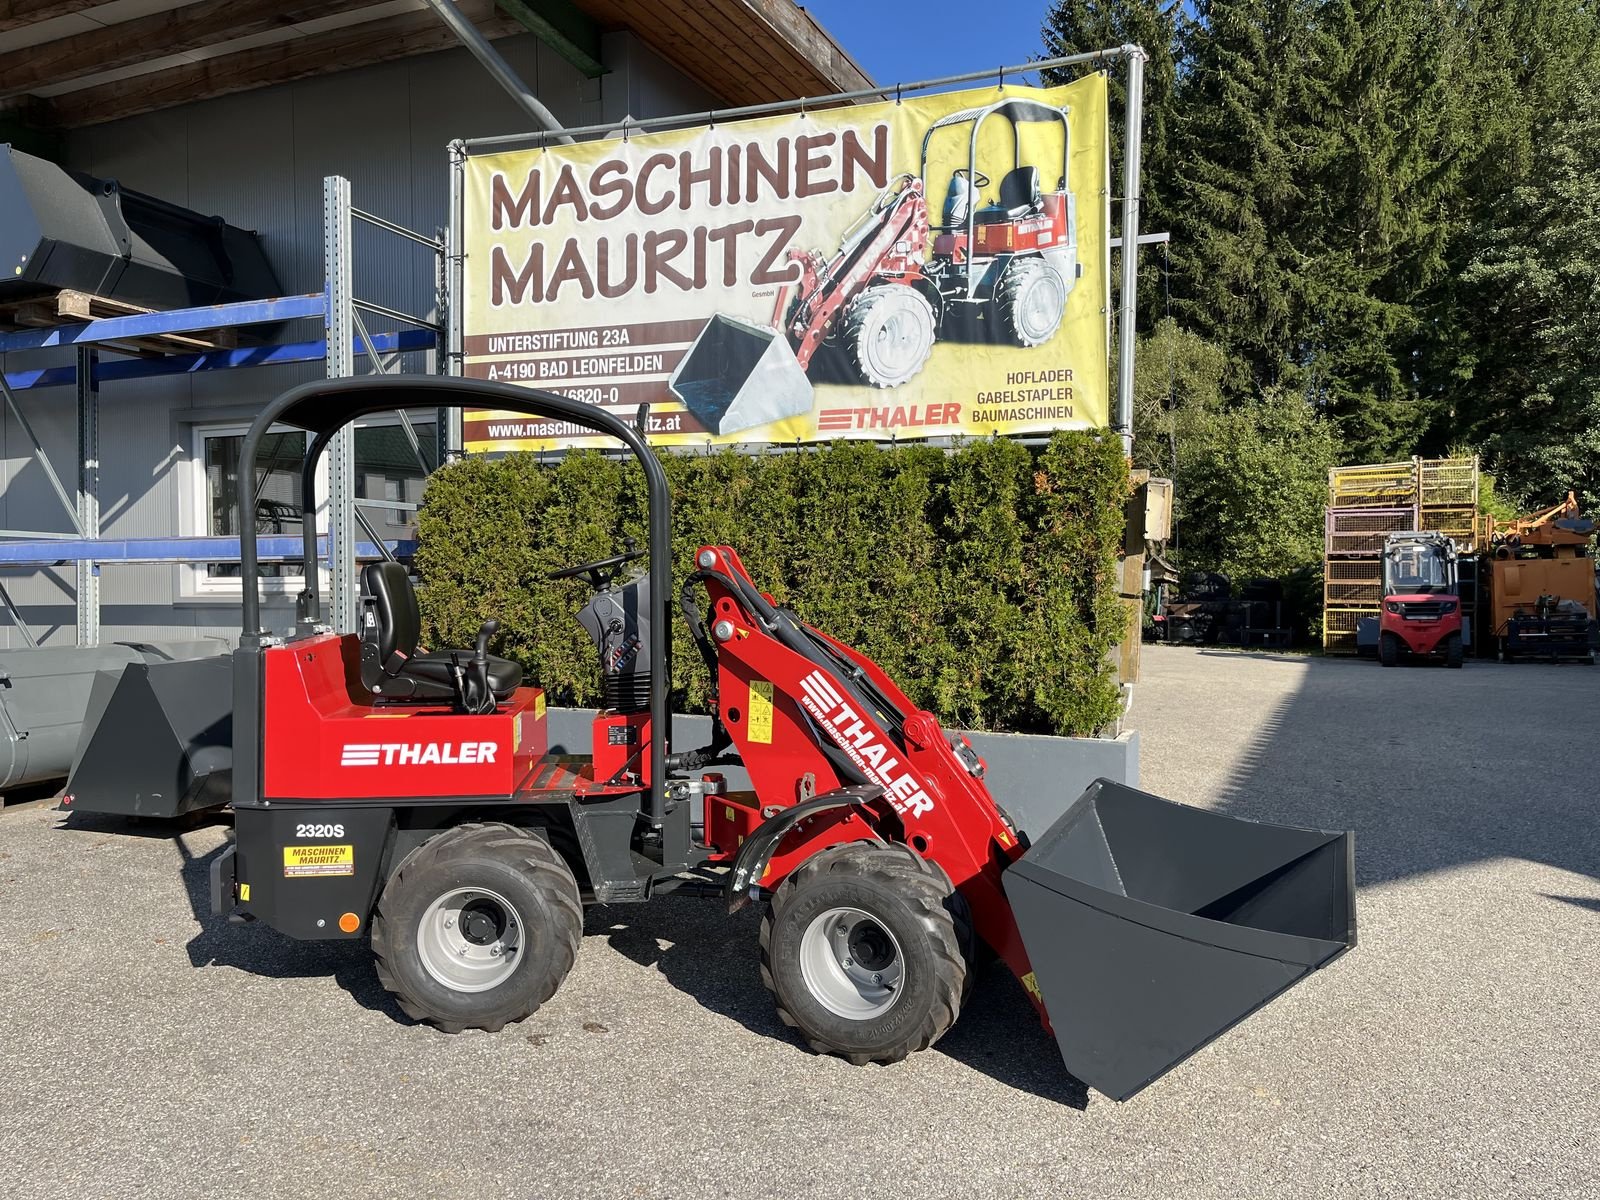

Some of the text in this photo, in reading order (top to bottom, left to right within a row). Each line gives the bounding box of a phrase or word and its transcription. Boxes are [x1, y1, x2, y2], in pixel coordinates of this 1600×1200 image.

[491, 124, 888, 231] MASCHINEN
[491, 214, 802, 306] MAURITZ
[751, 290, 775, 298] GesmbH
[488, 328, 630, 353] UNTERSTIFTUNG 23A
[488, 354, 663, 380] A-4190 BAD LEONFELDEN
[1007, 369, 1073, 385] HOFLADER
[977, 387, 1073, 405] GABELSTAPLER
[972, 405, 1073, 423] BAUMASCHINEN
[296, 824, 345, 838] 2320S
[292, 847, 346, 857] MASCHINEN
[299, 856, 340, 865] MAURITZ
